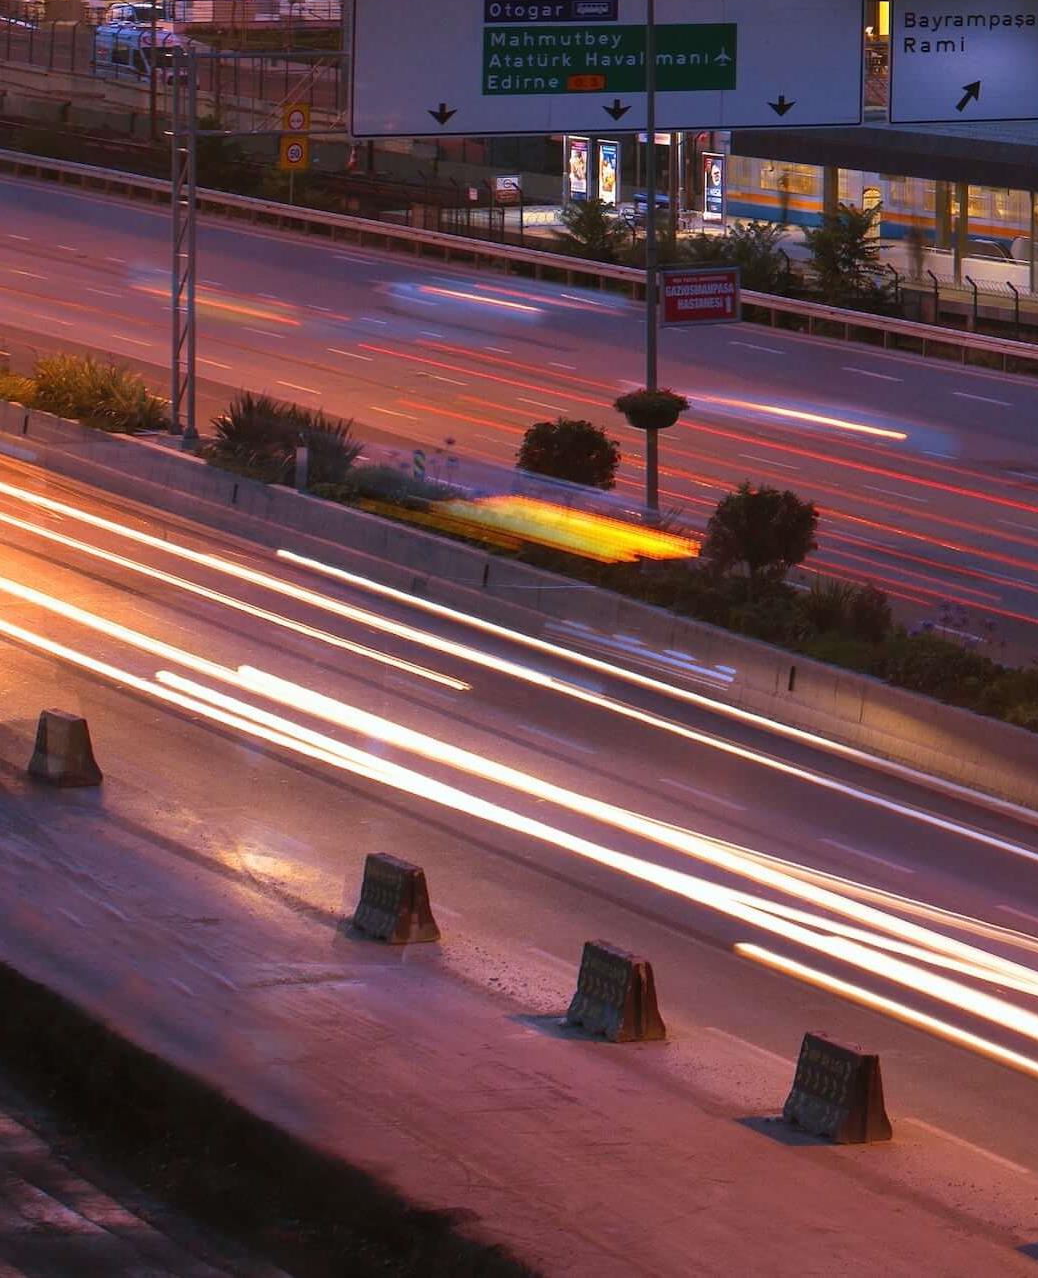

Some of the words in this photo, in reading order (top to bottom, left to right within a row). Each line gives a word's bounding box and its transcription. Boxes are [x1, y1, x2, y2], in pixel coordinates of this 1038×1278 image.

[489, 3, 565, 21] Otogar
[904, 12, 1036, 32] Bayrampaşa
[490, 31, 623, 49] Mahmutbey
[904, 36, 965, 53] Rami
[489, 52, 572, 68] Atatürk
[585, 52, 710, 67] Havalmanı
[487, 74, 559, 90] Edirne
